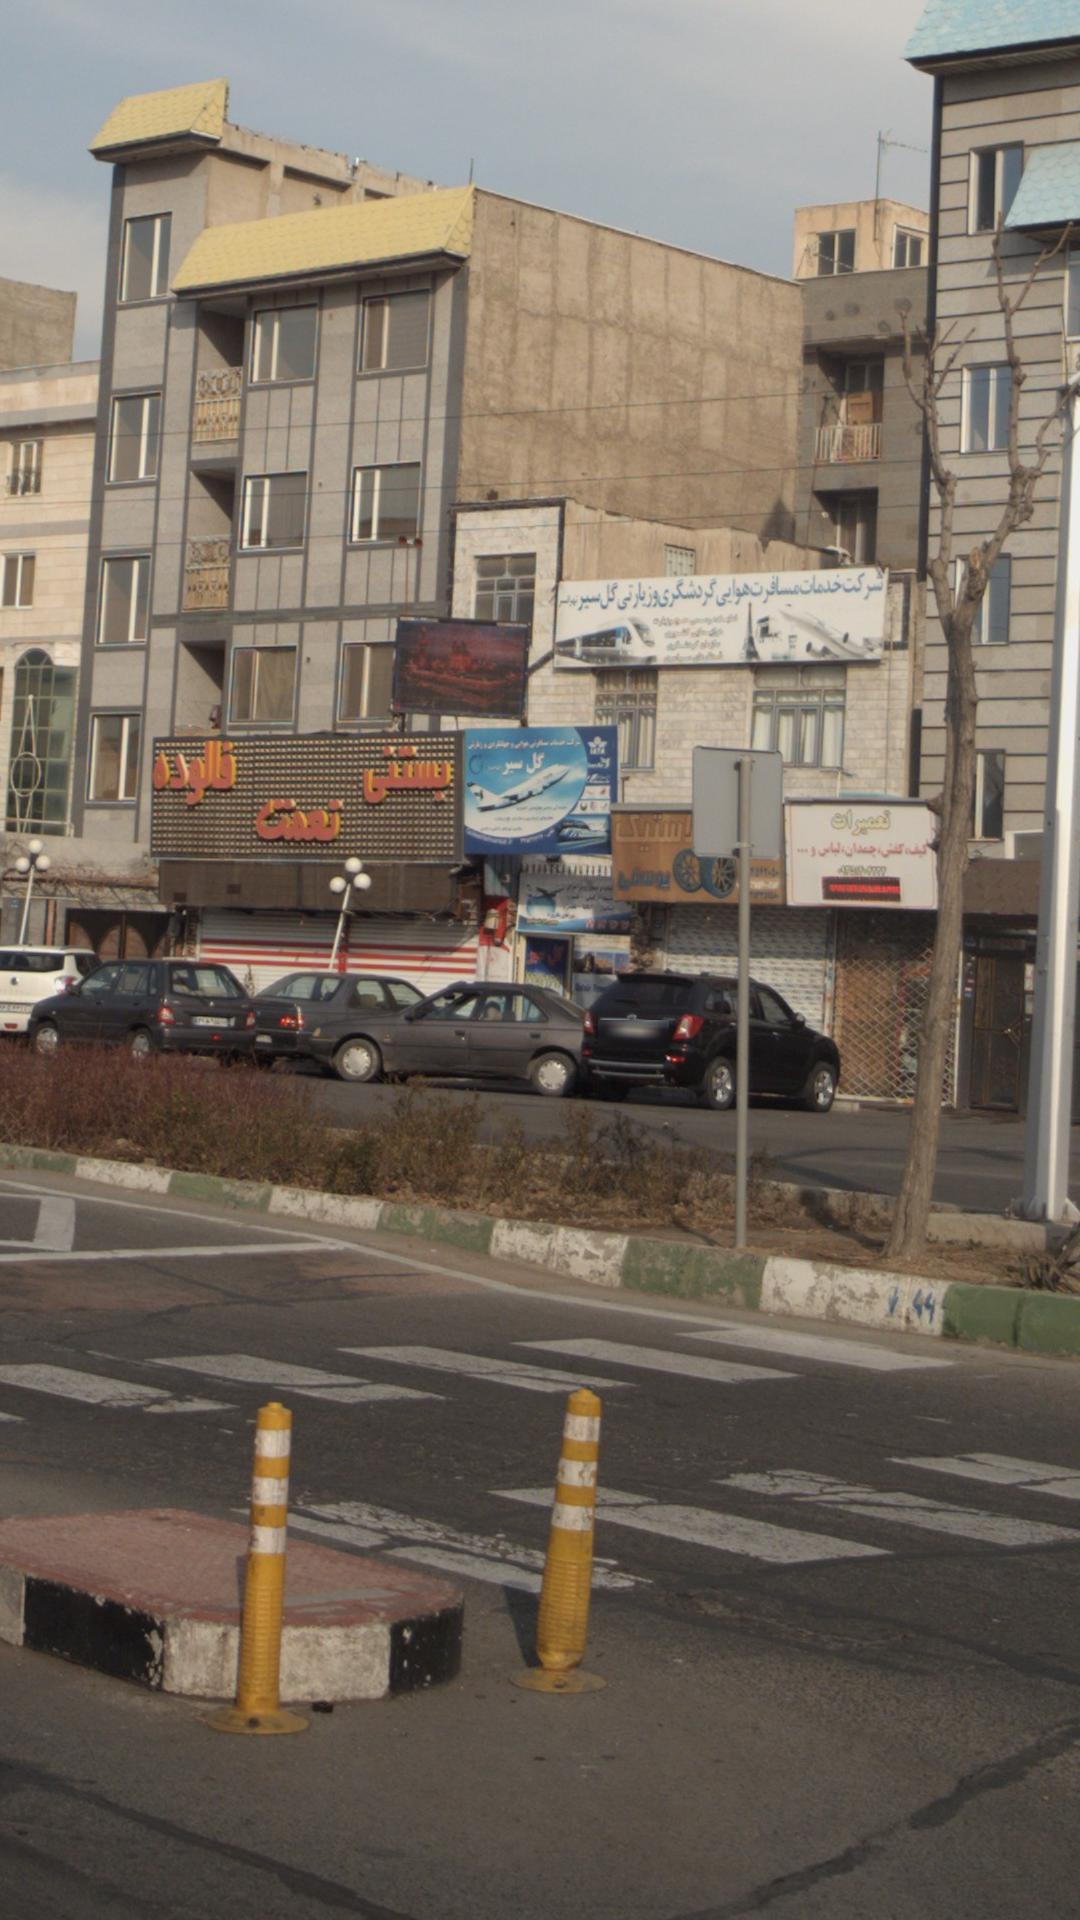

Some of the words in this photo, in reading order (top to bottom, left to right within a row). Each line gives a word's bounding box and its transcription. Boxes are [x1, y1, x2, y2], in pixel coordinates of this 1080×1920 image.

[599, 581, 618, 610] گل
[657, 577, 717, 608] گردشگری
[799, 573, 842, 594] خدمات
[843, 569, 884, 600] شرکت
[153, 740, 236, 806] فالوده
[364, 745, 451, 804] بستنی
[526, 752, 545, 775] گل
[256, 799, 344, 842] نعمت
[830, 808, 892, 837] تعمیرات
